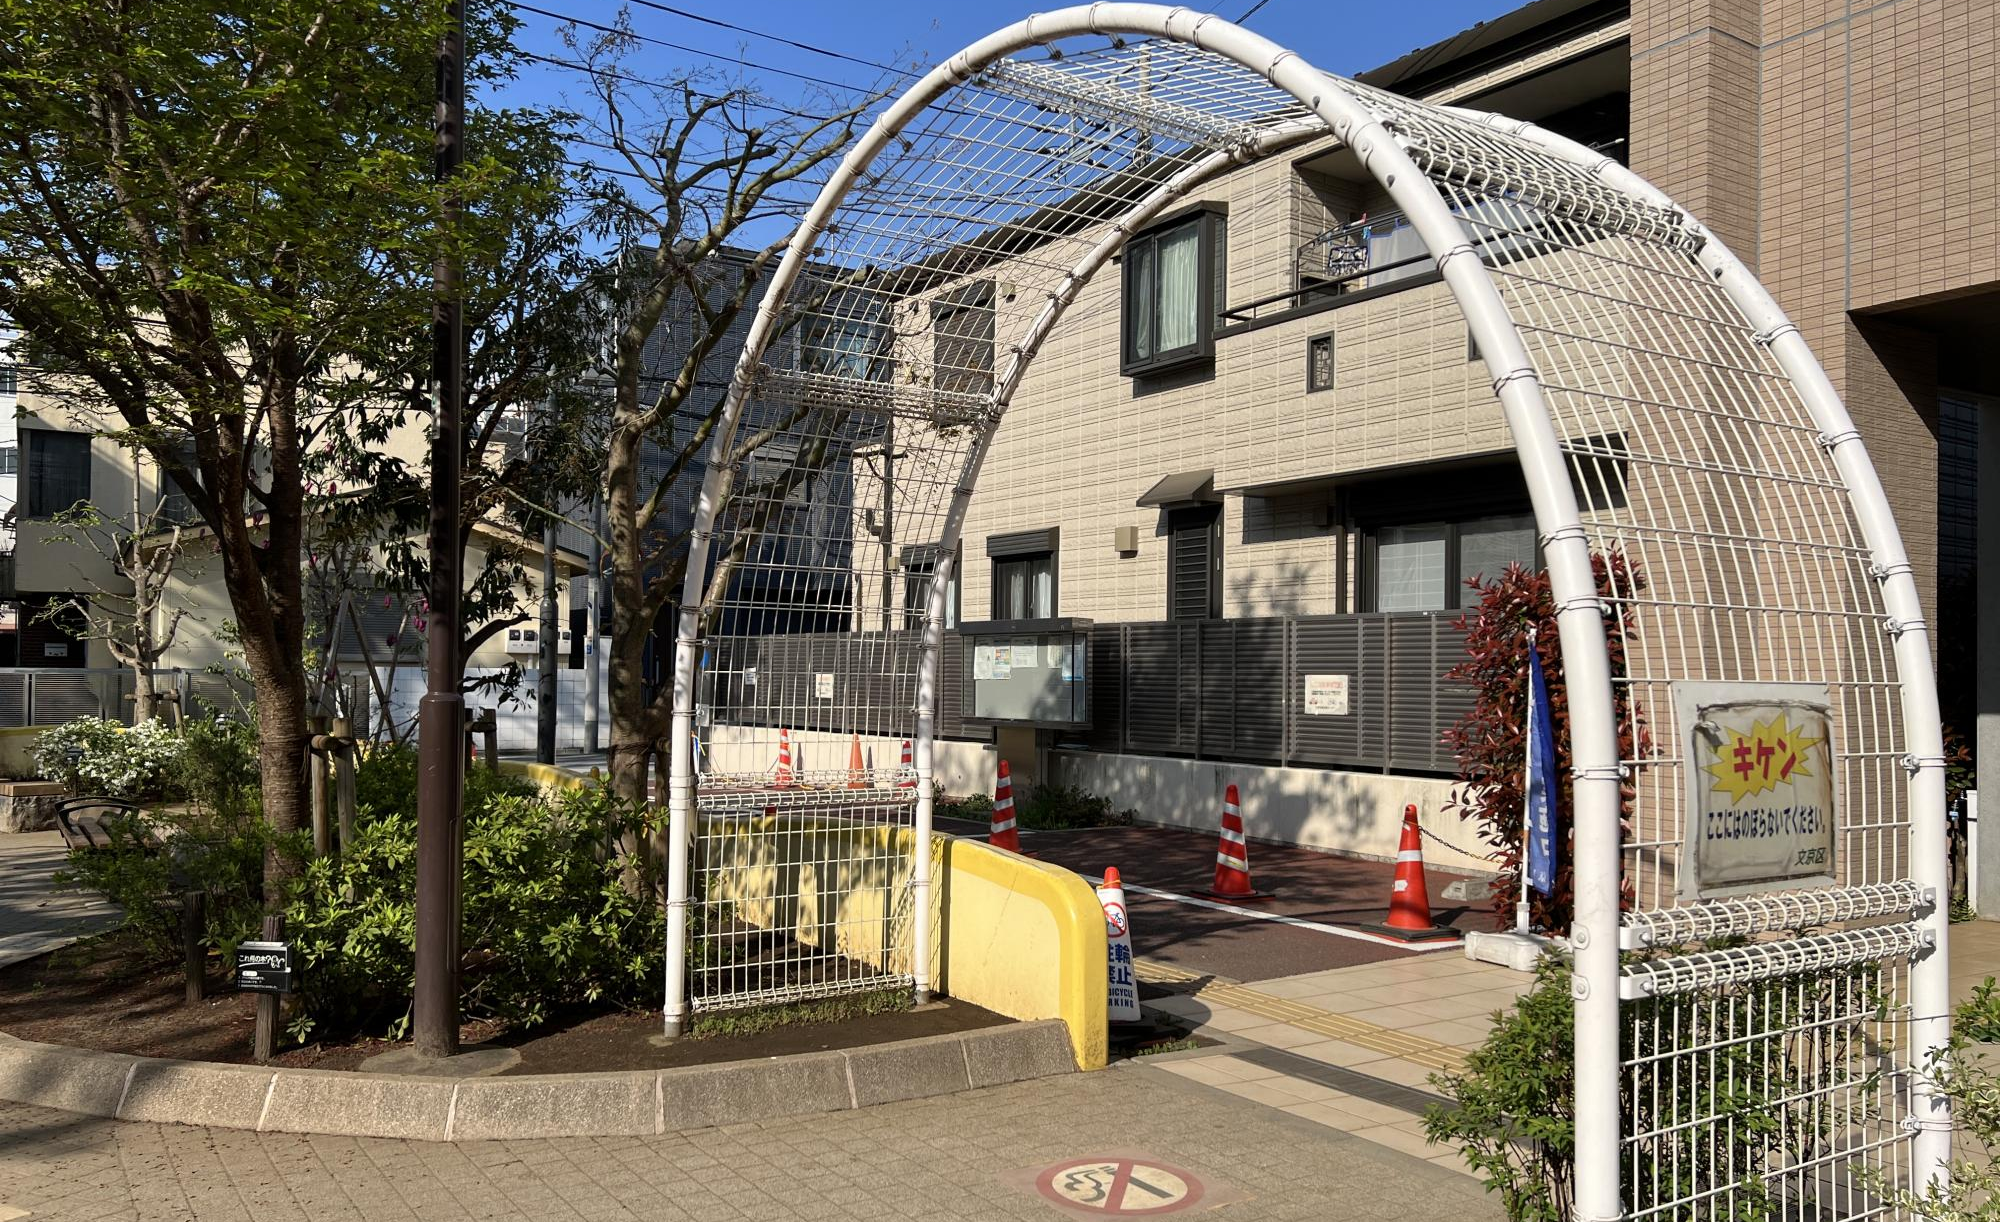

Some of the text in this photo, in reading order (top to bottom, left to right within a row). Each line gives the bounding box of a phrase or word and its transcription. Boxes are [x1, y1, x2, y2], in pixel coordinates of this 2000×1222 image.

[1732, 737, 1797, 782] キケン
[1707, 805, 1826, 840] ここにはのぼらないでください。
[1795, 848, 1826, 866] 文京区
[1108, 997, 1134, 1009] RKING
